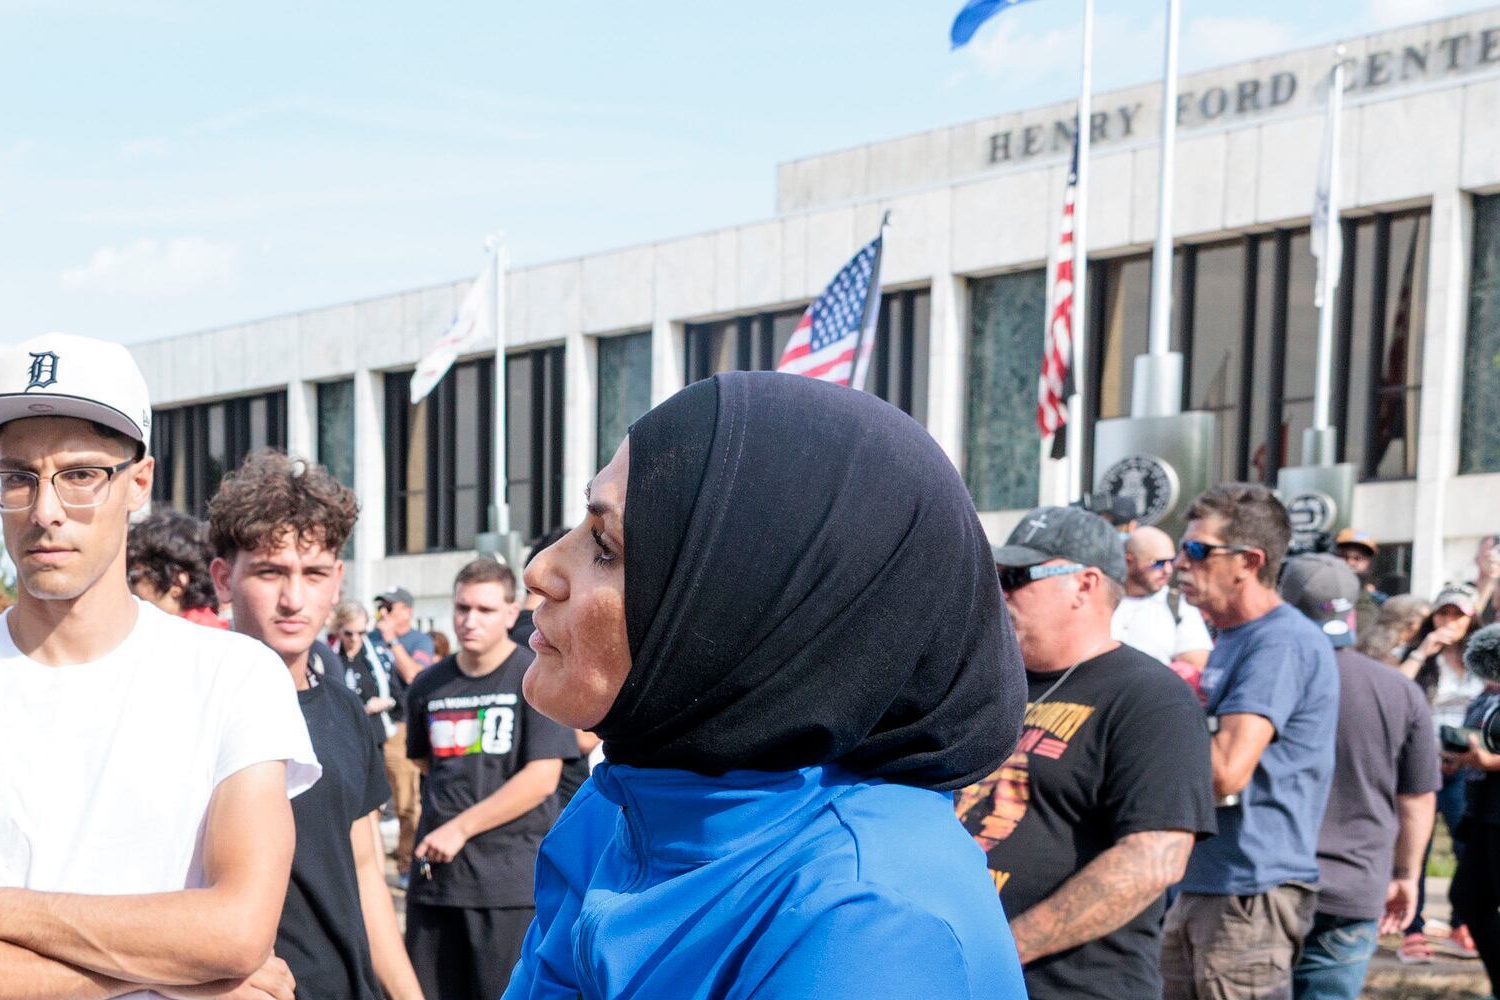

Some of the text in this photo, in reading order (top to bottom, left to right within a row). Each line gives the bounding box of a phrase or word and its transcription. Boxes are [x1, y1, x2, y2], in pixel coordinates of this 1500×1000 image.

[989, 102, 1142, 164] HENRY
[1175, 70, 1297, 127] FORD
[25, 351, 60, 393] D
